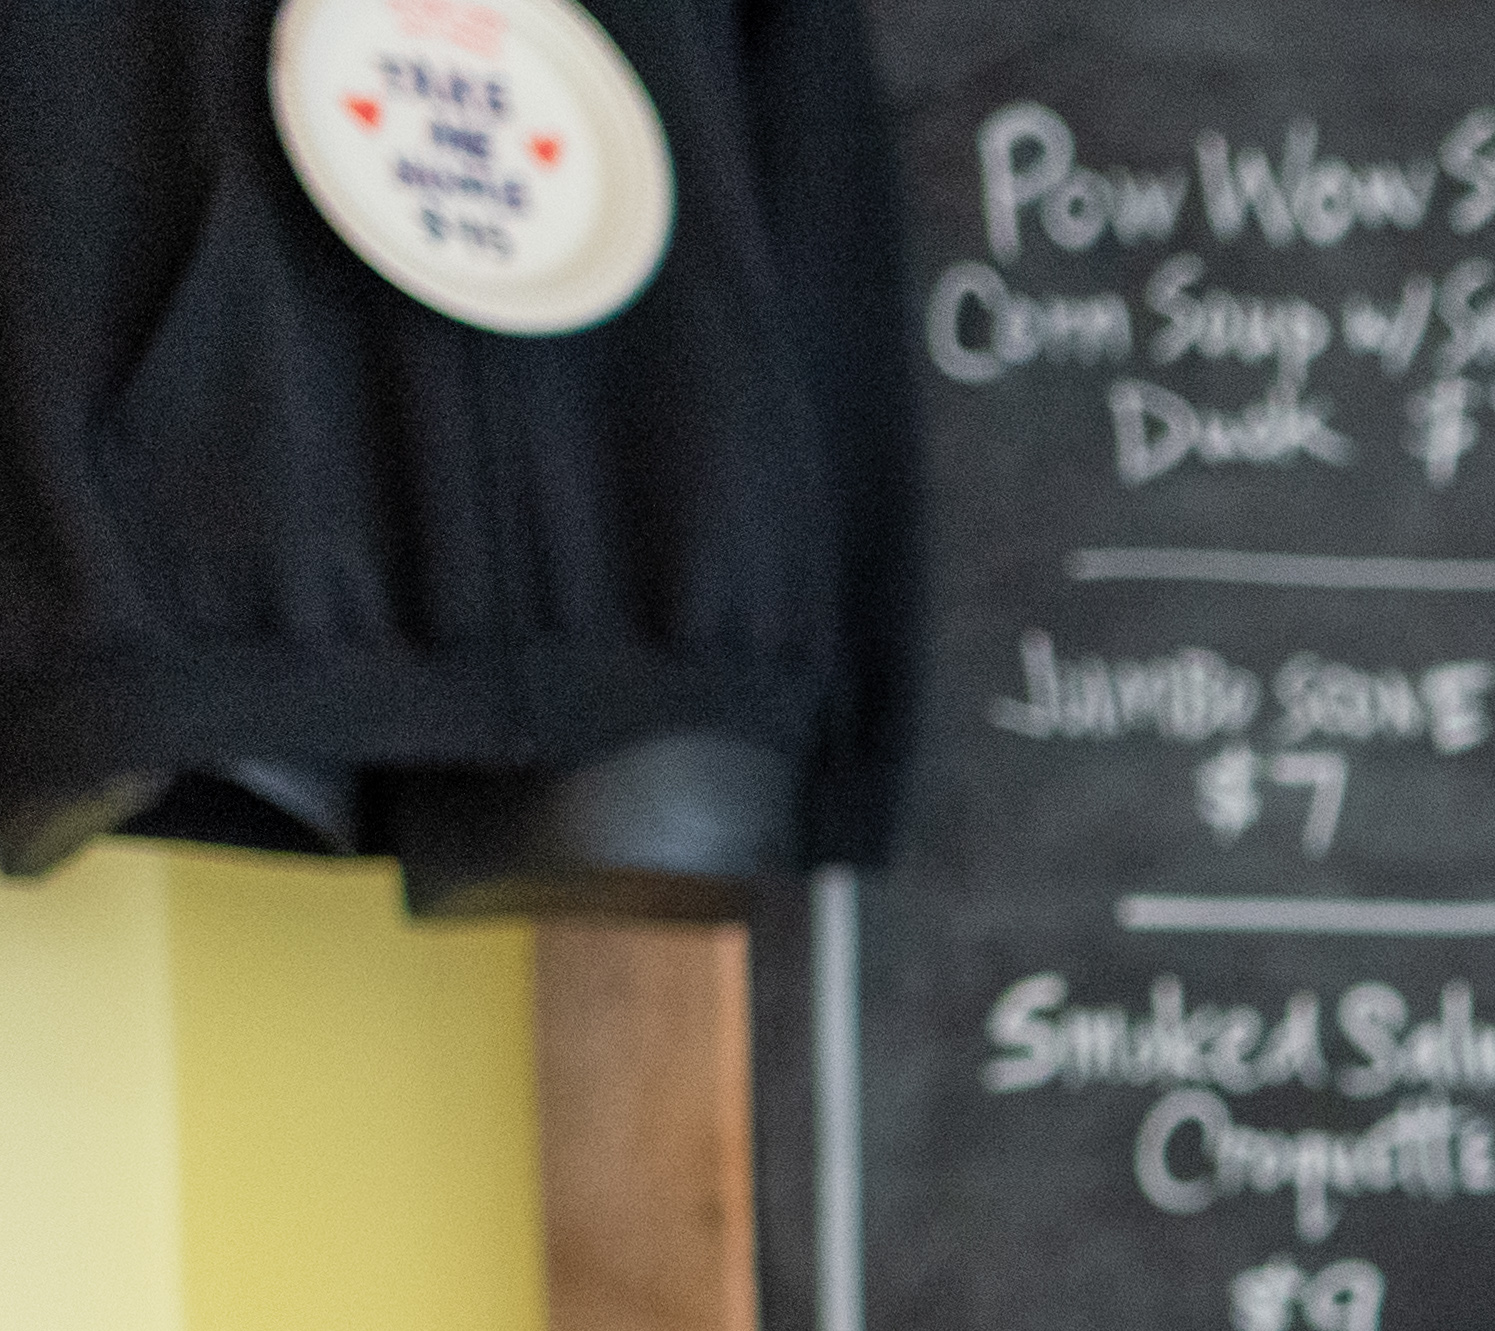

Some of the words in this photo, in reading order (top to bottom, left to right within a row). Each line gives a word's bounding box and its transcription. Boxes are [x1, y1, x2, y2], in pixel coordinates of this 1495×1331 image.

[979, 101, 1188, 266] Pow
[1197, 114, 1436, 246] Wow
[927, 260, 1133, 384] Corn
[1145, 253, 1330, 392] Soup
[1107, 378, 1358, 488] Duck
[1193, 742, 1348, 860] $7
[980, 970, 1328, 1096] Smoked
